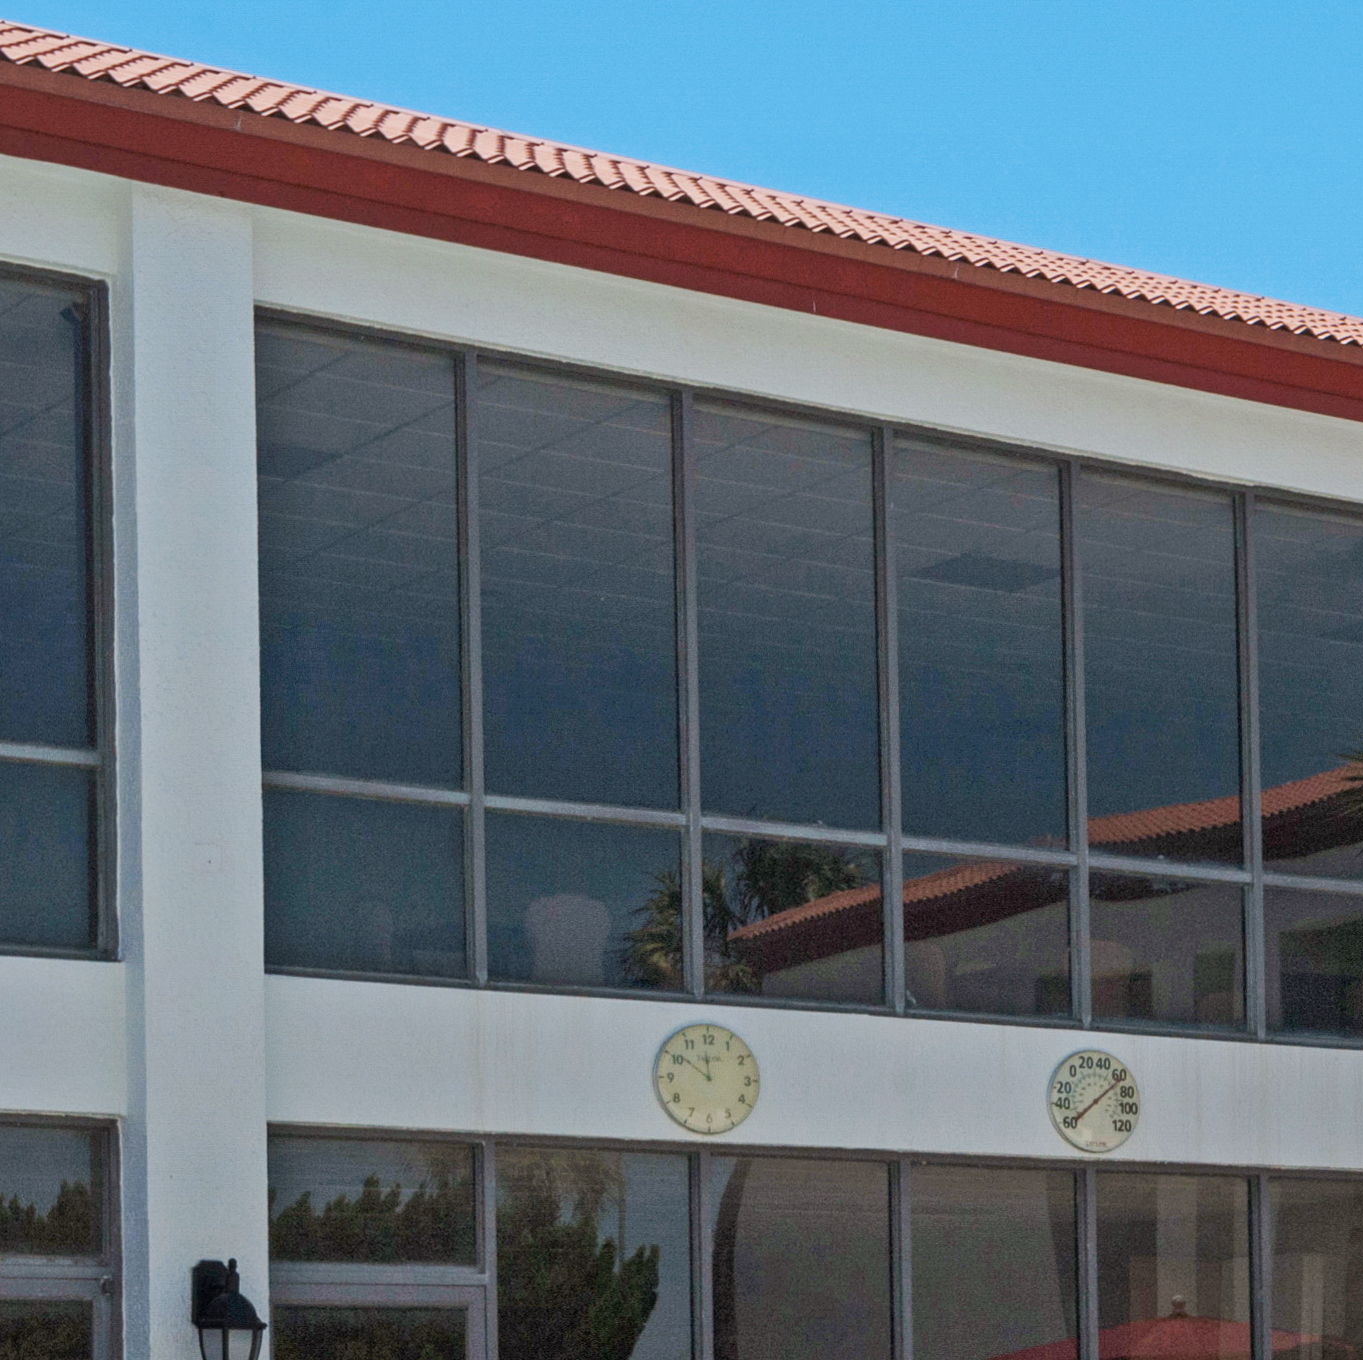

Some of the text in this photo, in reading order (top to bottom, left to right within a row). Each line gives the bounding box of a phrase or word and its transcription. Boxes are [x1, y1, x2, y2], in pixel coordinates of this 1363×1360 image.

[684, 1039, 694, 1050] 11
[702, 1034, 716, 1045] 12
[725, 1041, 730, 1051] 1
[672, 1054, 684, 1065] 10
[737, 1055, 745, 1066] 2
[1079, 1056, 1094, 1069] 20
[1096, 1058, 1111, 1070] 40
[1069, 1065, 1077, 1077] 0
[1112, 1069, 1127, 1081] 60
[666, 1072, 675, 1083] 9
[744, 1076, 751, 1087] 3
[1120, 1086, 1134, 1098] 80
[672, 1093, 681, 1104] 8
[738, 1094, 745, 1104] 4
[688, 1107, 695, 1117] 7
[724, 1108, 731, 1119] 5
[1119, 1102, 1138, 1115] 100
[706, 1113, 713, 1123] 6
[1112, 1119, 1132, 1133] 120
